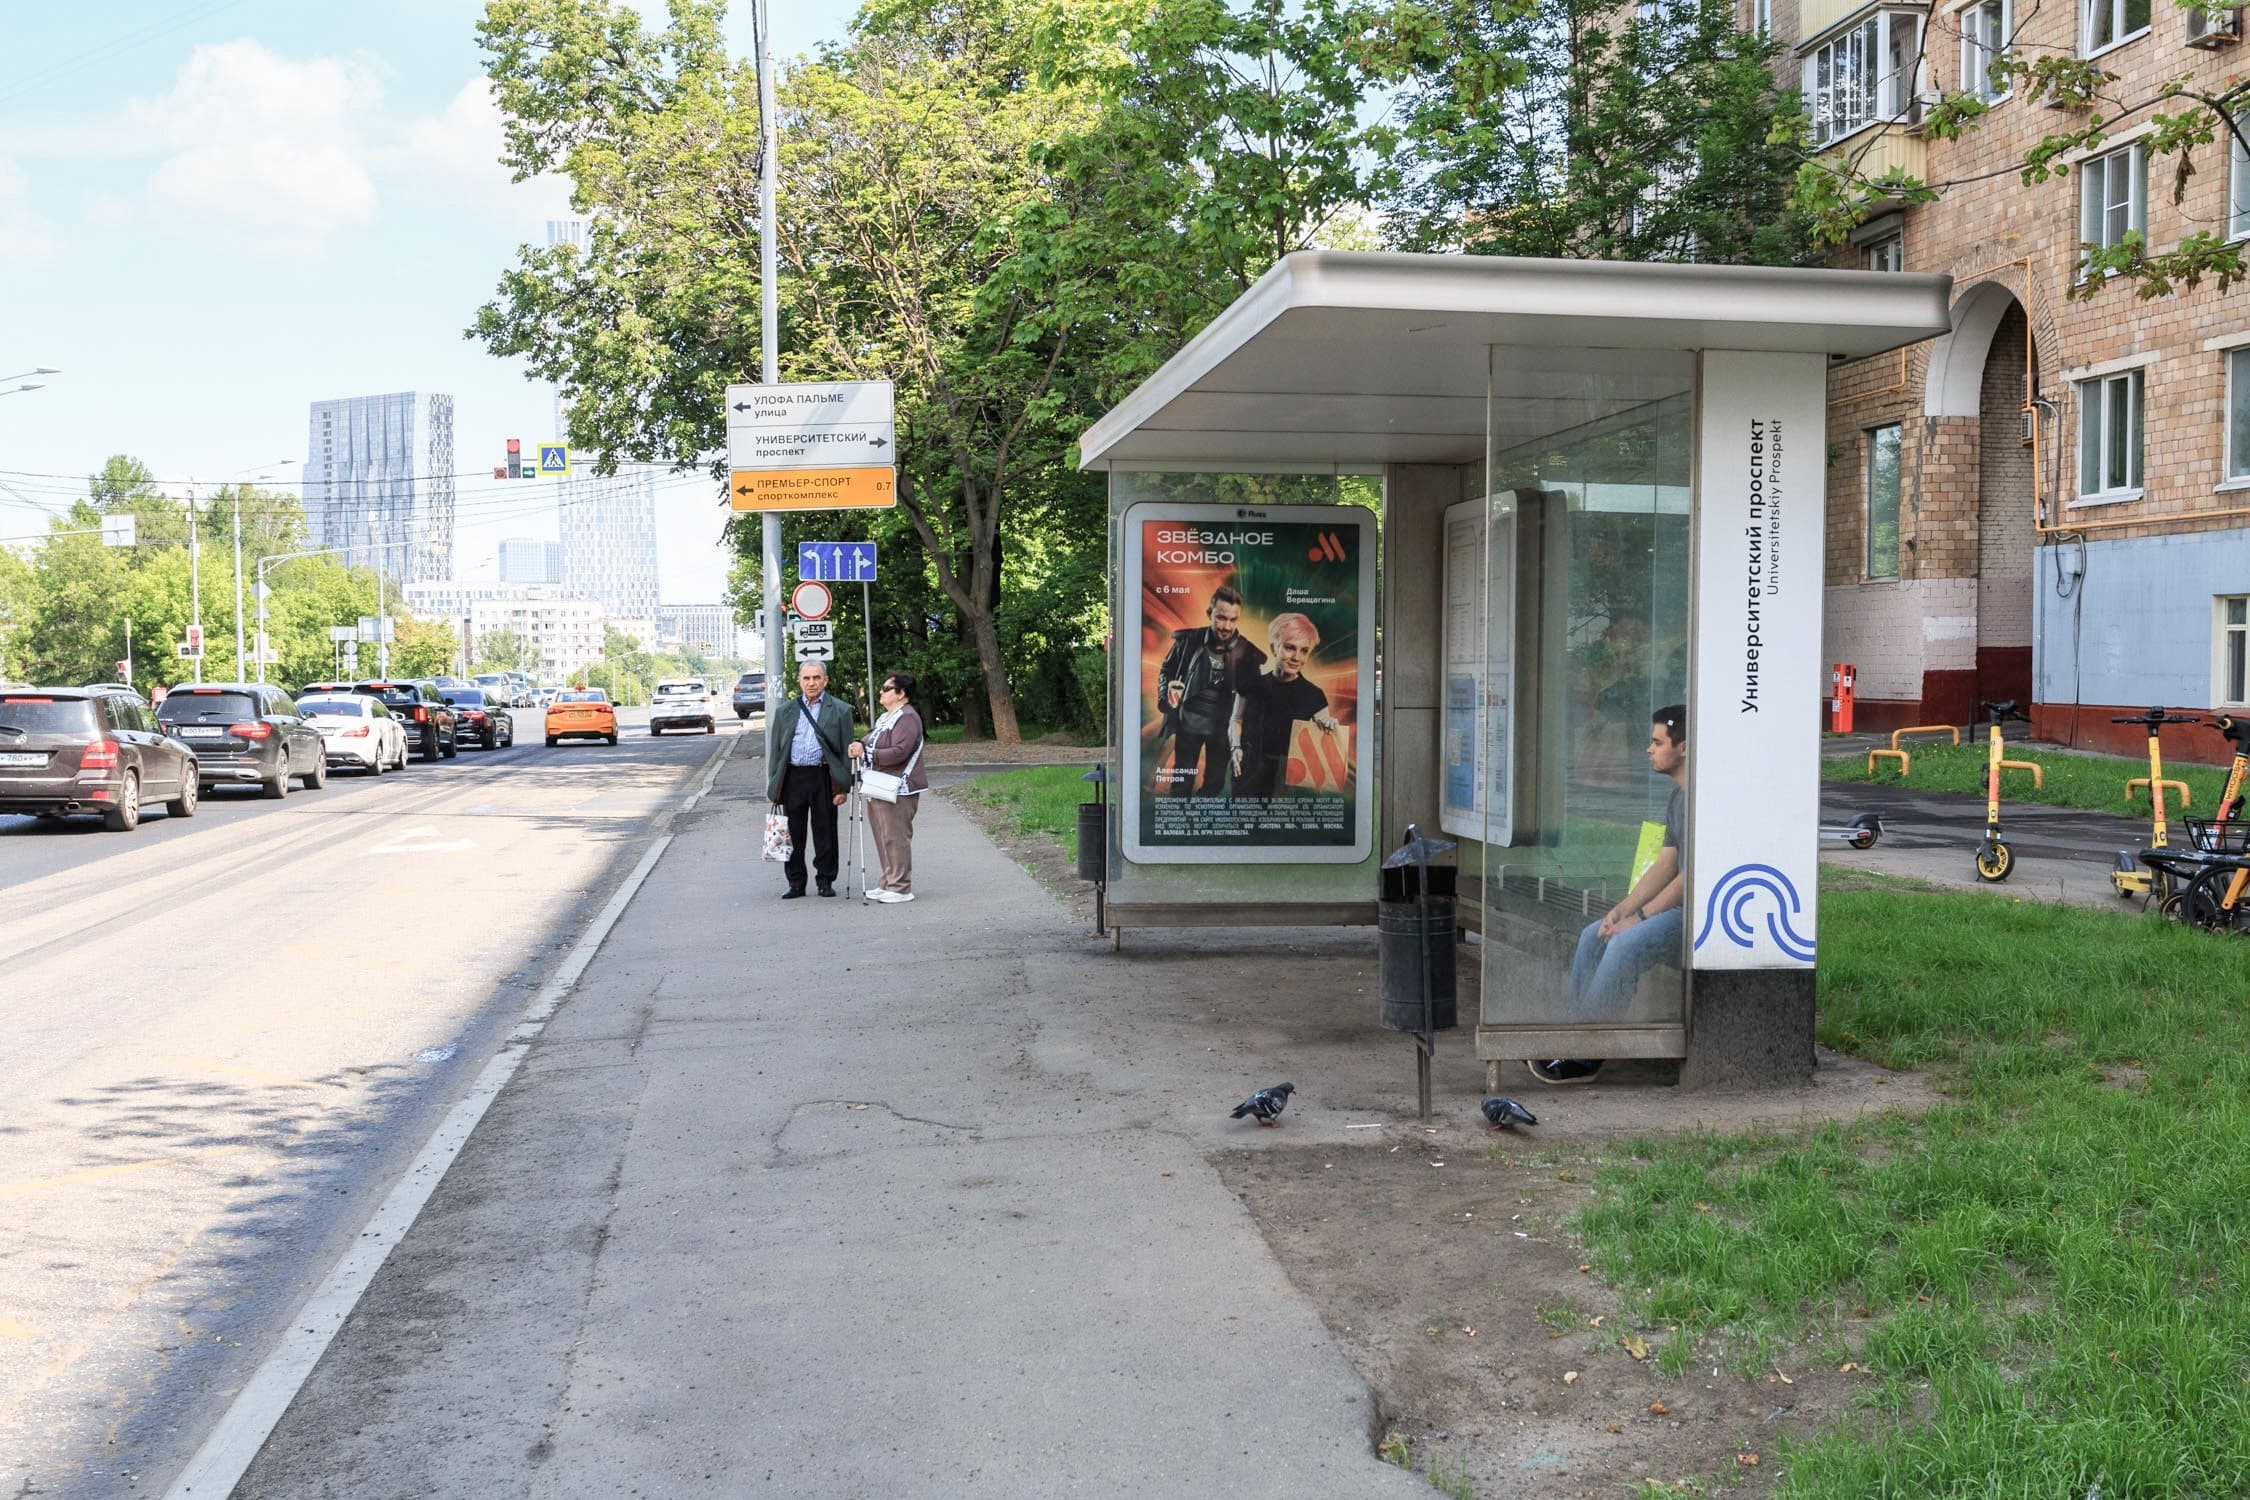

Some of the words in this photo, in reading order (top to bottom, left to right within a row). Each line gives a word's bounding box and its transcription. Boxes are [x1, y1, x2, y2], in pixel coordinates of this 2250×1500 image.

[754, 395, 794, 405] УЛОФА
[796, 393, 845, 404] ПАЛЬМЕ
[754, 409, 787, 419] улица
[755, 431, 867, 445] УНИВЕРСИТЕТСКИЙ
[756, 448, 805, 458] проспект
[1768, 418, 1783, 483] Prospekt
[1749, 418, 1766, 519] проспект
[757, 477, 852, 489] ПРЕМЬЕР-СПОРТ
[757, 491, 839, 501] спорткомплекс
[1157, 528, 1274, 545] ЗВЁЗДНОЕ
[1767, 486, 1782, 595] Universitetskiy
[1157, 551, 1235, 564] КОМБО
[1163, 585, 1170, 594] 6
[1286, 587, 1309, 596] Даша
[1286, 596, 1336, 604] Верещагина
[1742, 526, 1764, 713] Университетский
[1155, 767, 1199, 775] Александр
